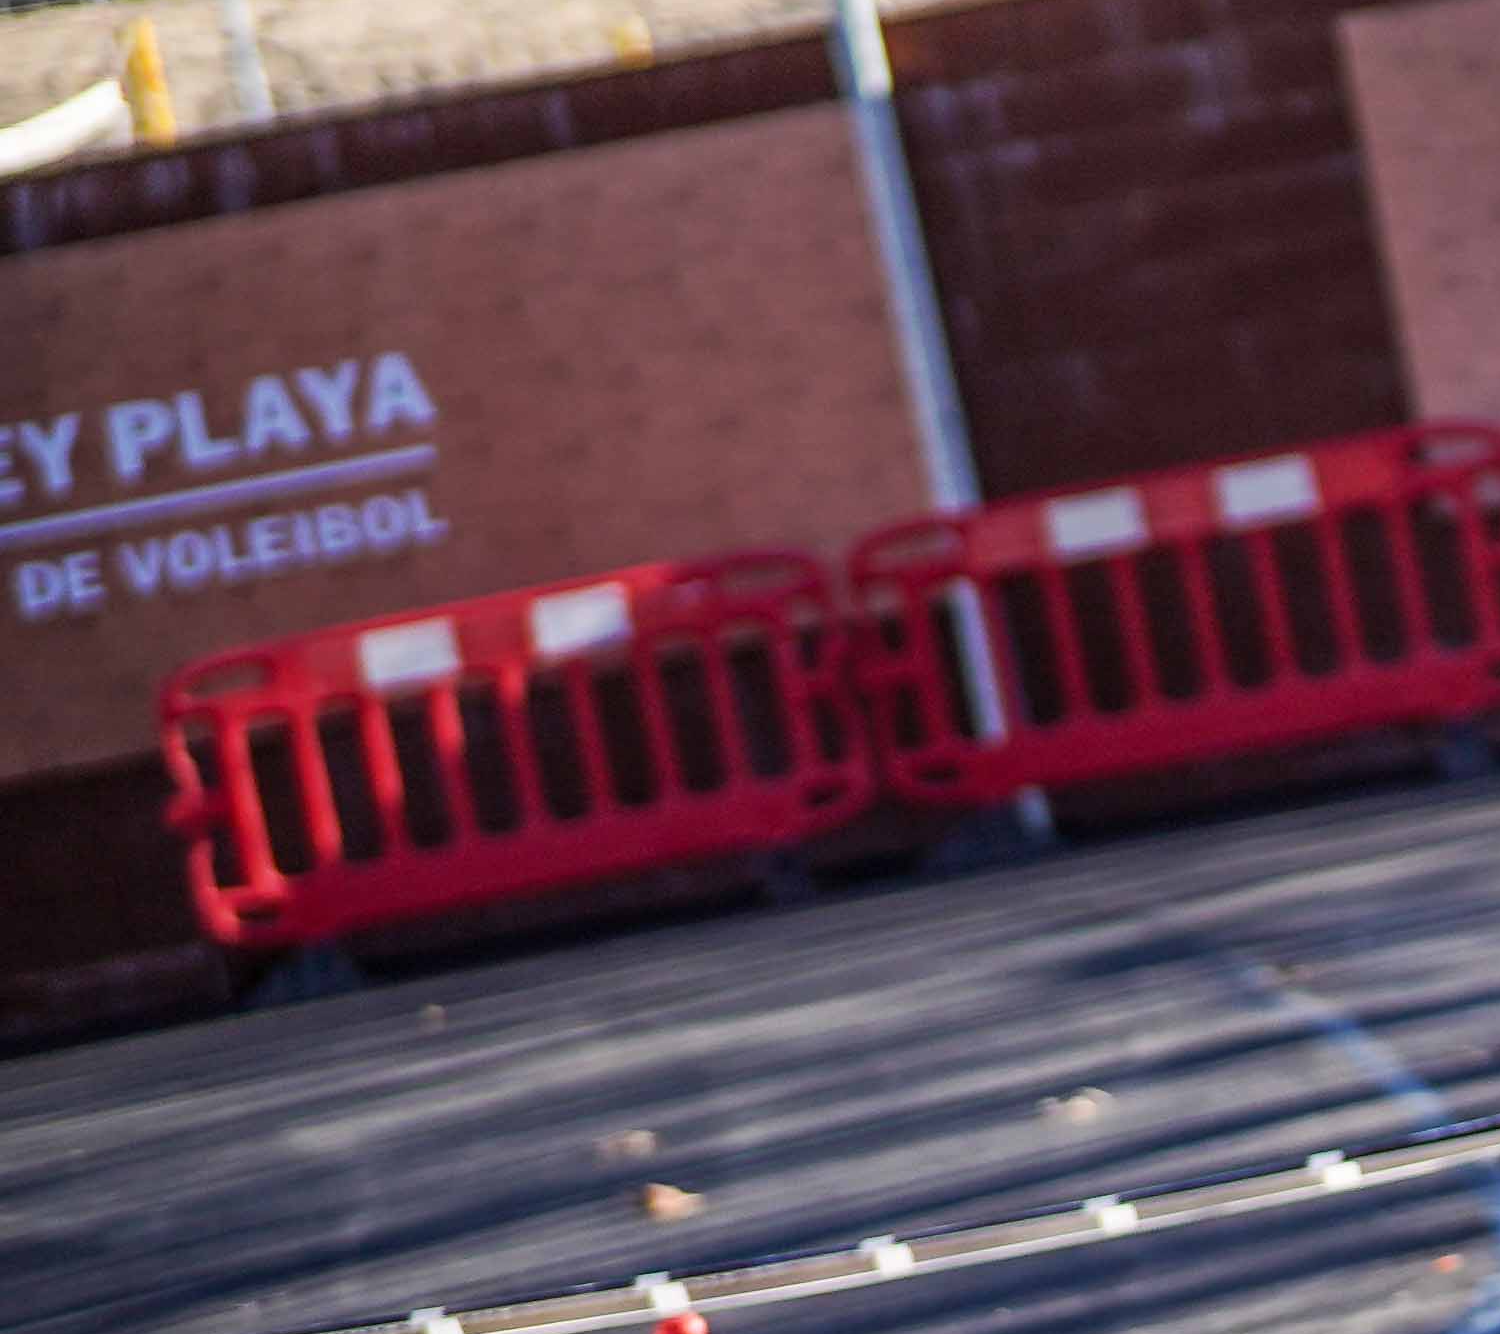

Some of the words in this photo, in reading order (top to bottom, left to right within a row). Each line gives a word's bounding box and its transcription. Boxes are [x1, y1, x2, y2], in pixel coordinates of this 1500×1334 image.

[106, 351, 438, 482] PLAYA
[16, 552, 105, 620] DE
[118, 490, 448, 595] VOLEIBOL
